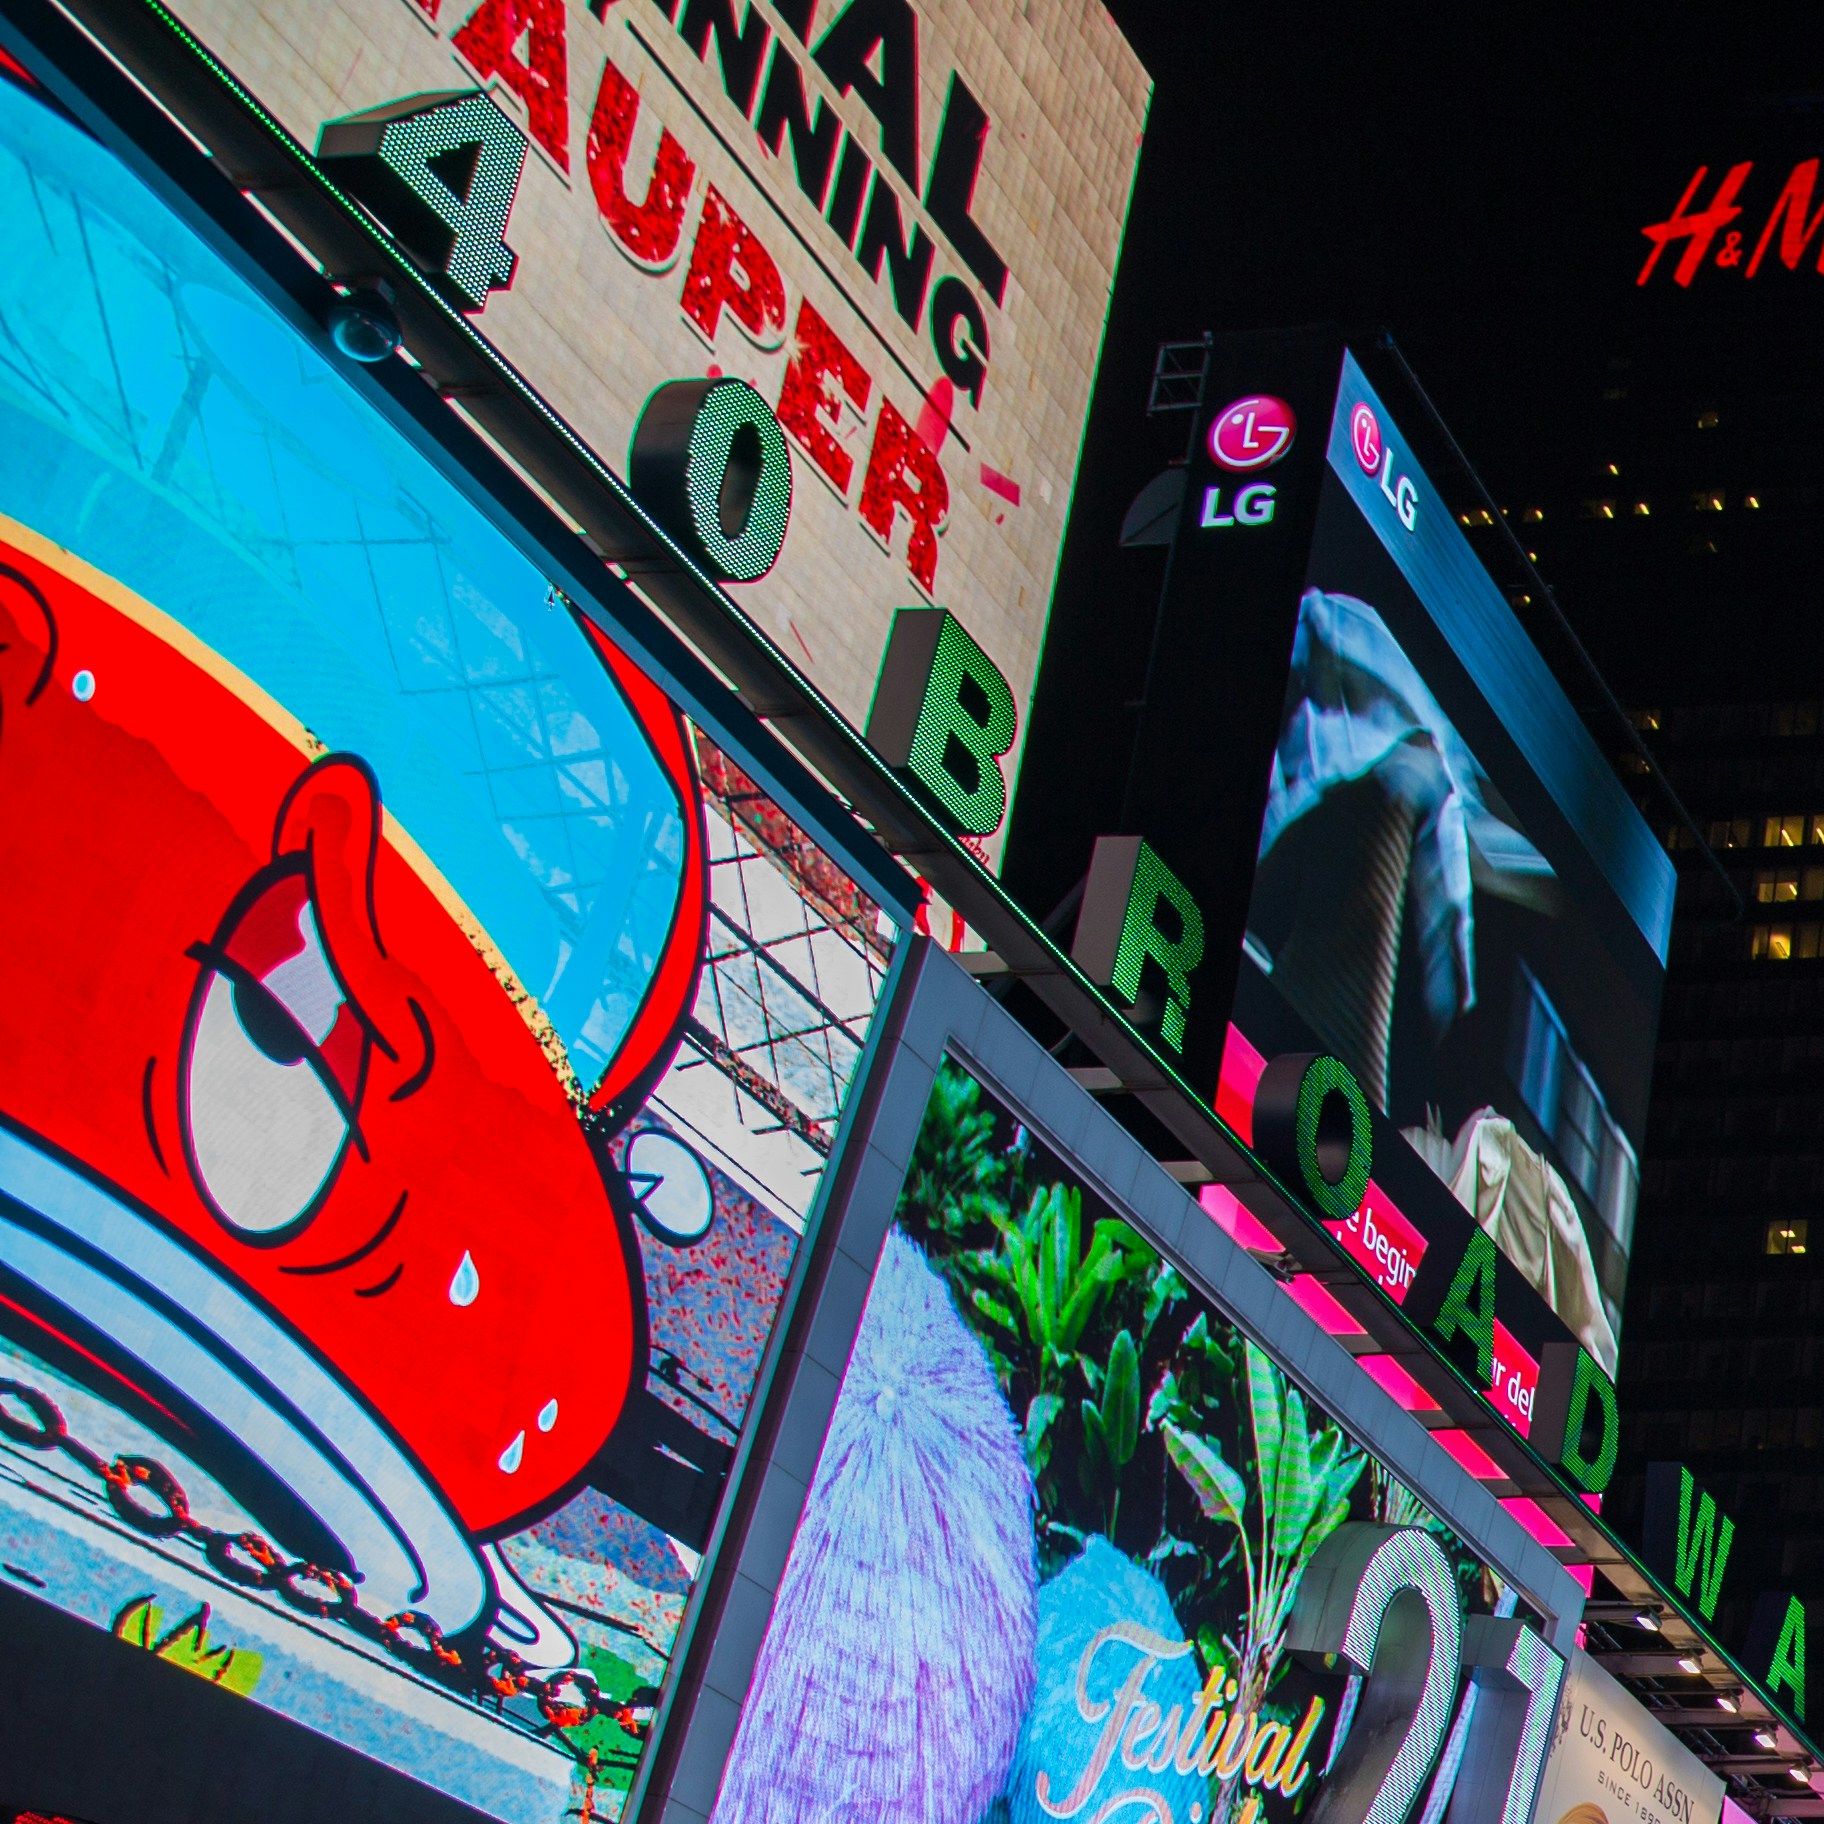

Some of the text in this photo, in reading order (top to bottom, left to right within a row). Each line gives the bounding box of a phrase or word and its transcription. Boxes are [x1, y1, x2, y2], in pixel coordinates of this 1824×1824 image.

[773, 0, 1009, 310] AL
[412, 0, 951, 596] AUPER
[1201, 484, 1277, 527] LG
[1379, 448, 1420, 532] LG
[1035, 1620, 1325, 1820] Festival
[1578, 1703, 1608, 1750] U.S.
[1609, 1732, 1653, 1792] POLO
[1597, 1769, 1632, 1809] SINCE
